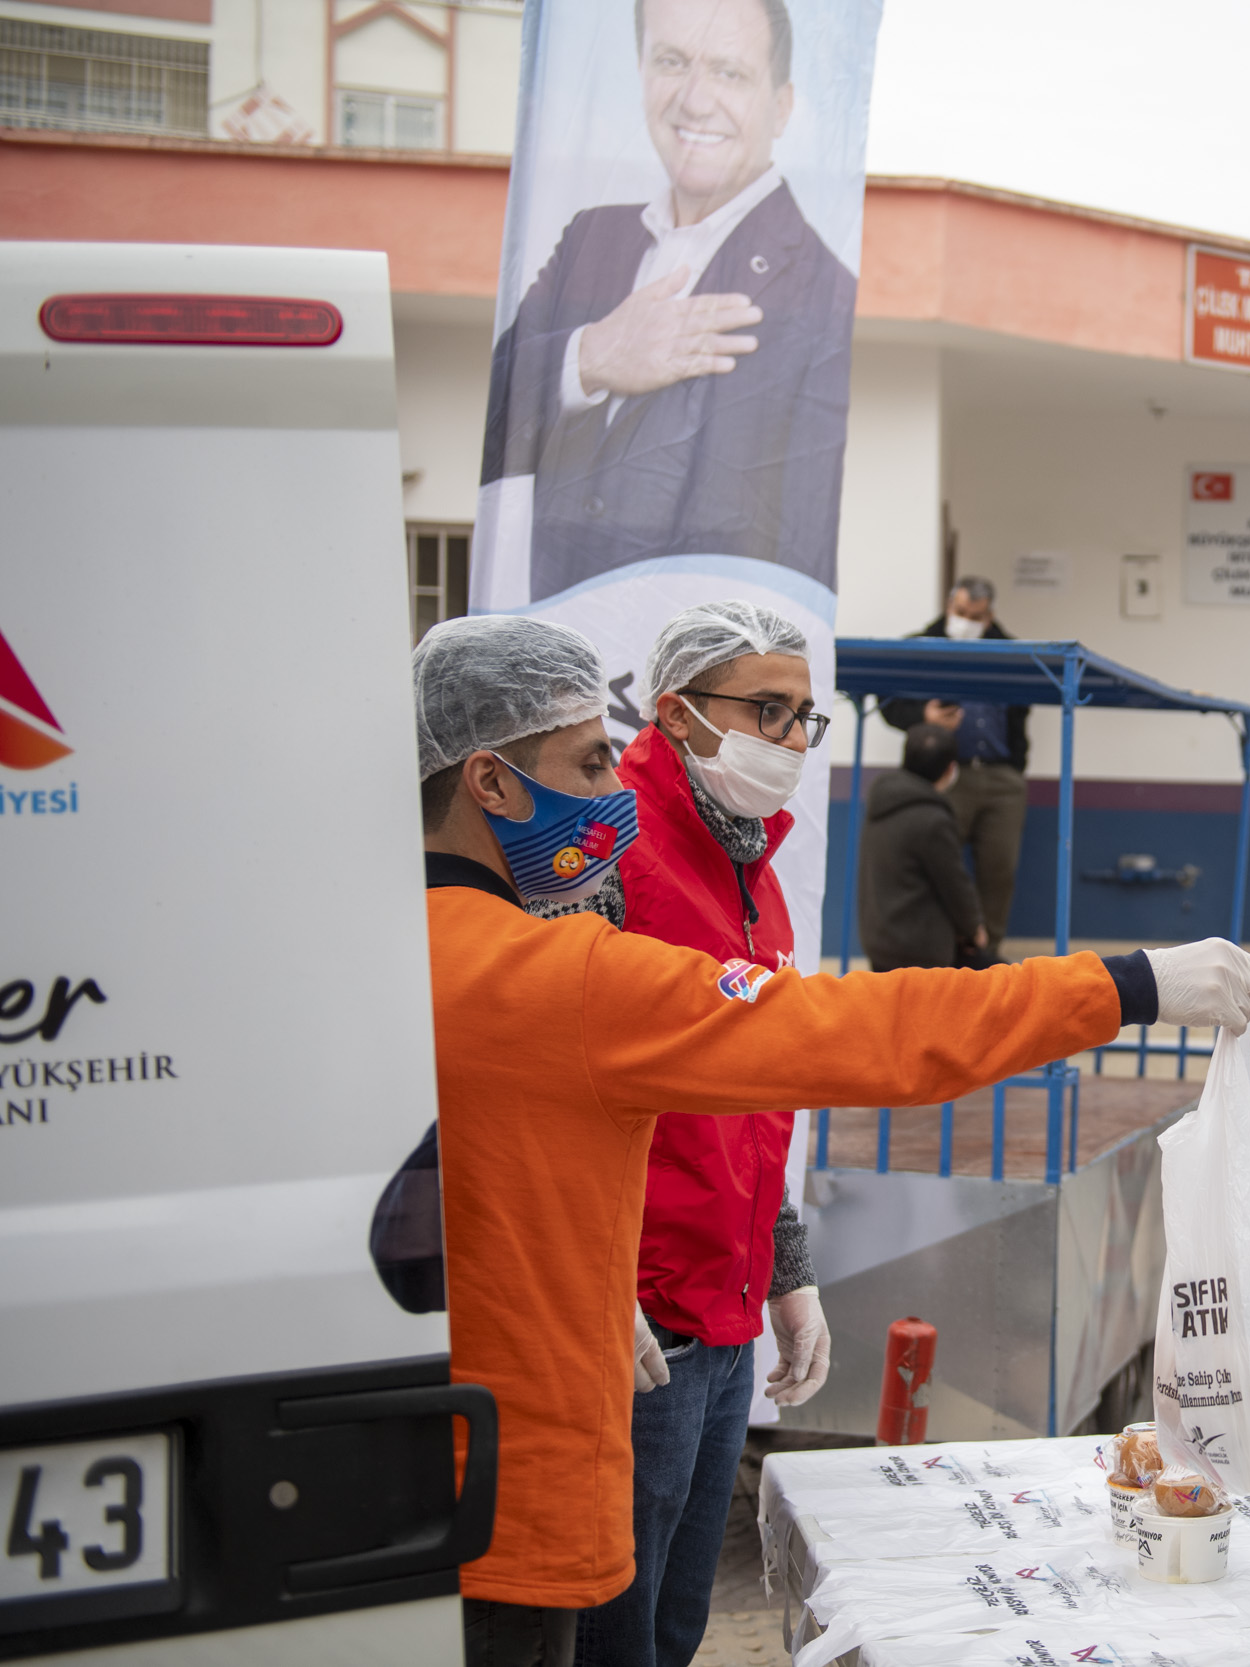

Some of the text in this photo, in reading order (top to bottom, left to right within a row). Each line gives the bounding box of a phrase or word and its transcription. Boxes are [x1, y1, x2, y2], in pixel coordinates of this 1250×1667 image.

[577, 825, 607, 840] MESAFELİ
[1173, 1276, 1228, 1308] SIFIR
[1187, 1370, 1213, 1390] Sahip
[8, 1455, 144, 1580] 43
[1137, 1528, 1163, 1542] AYNIYOR
